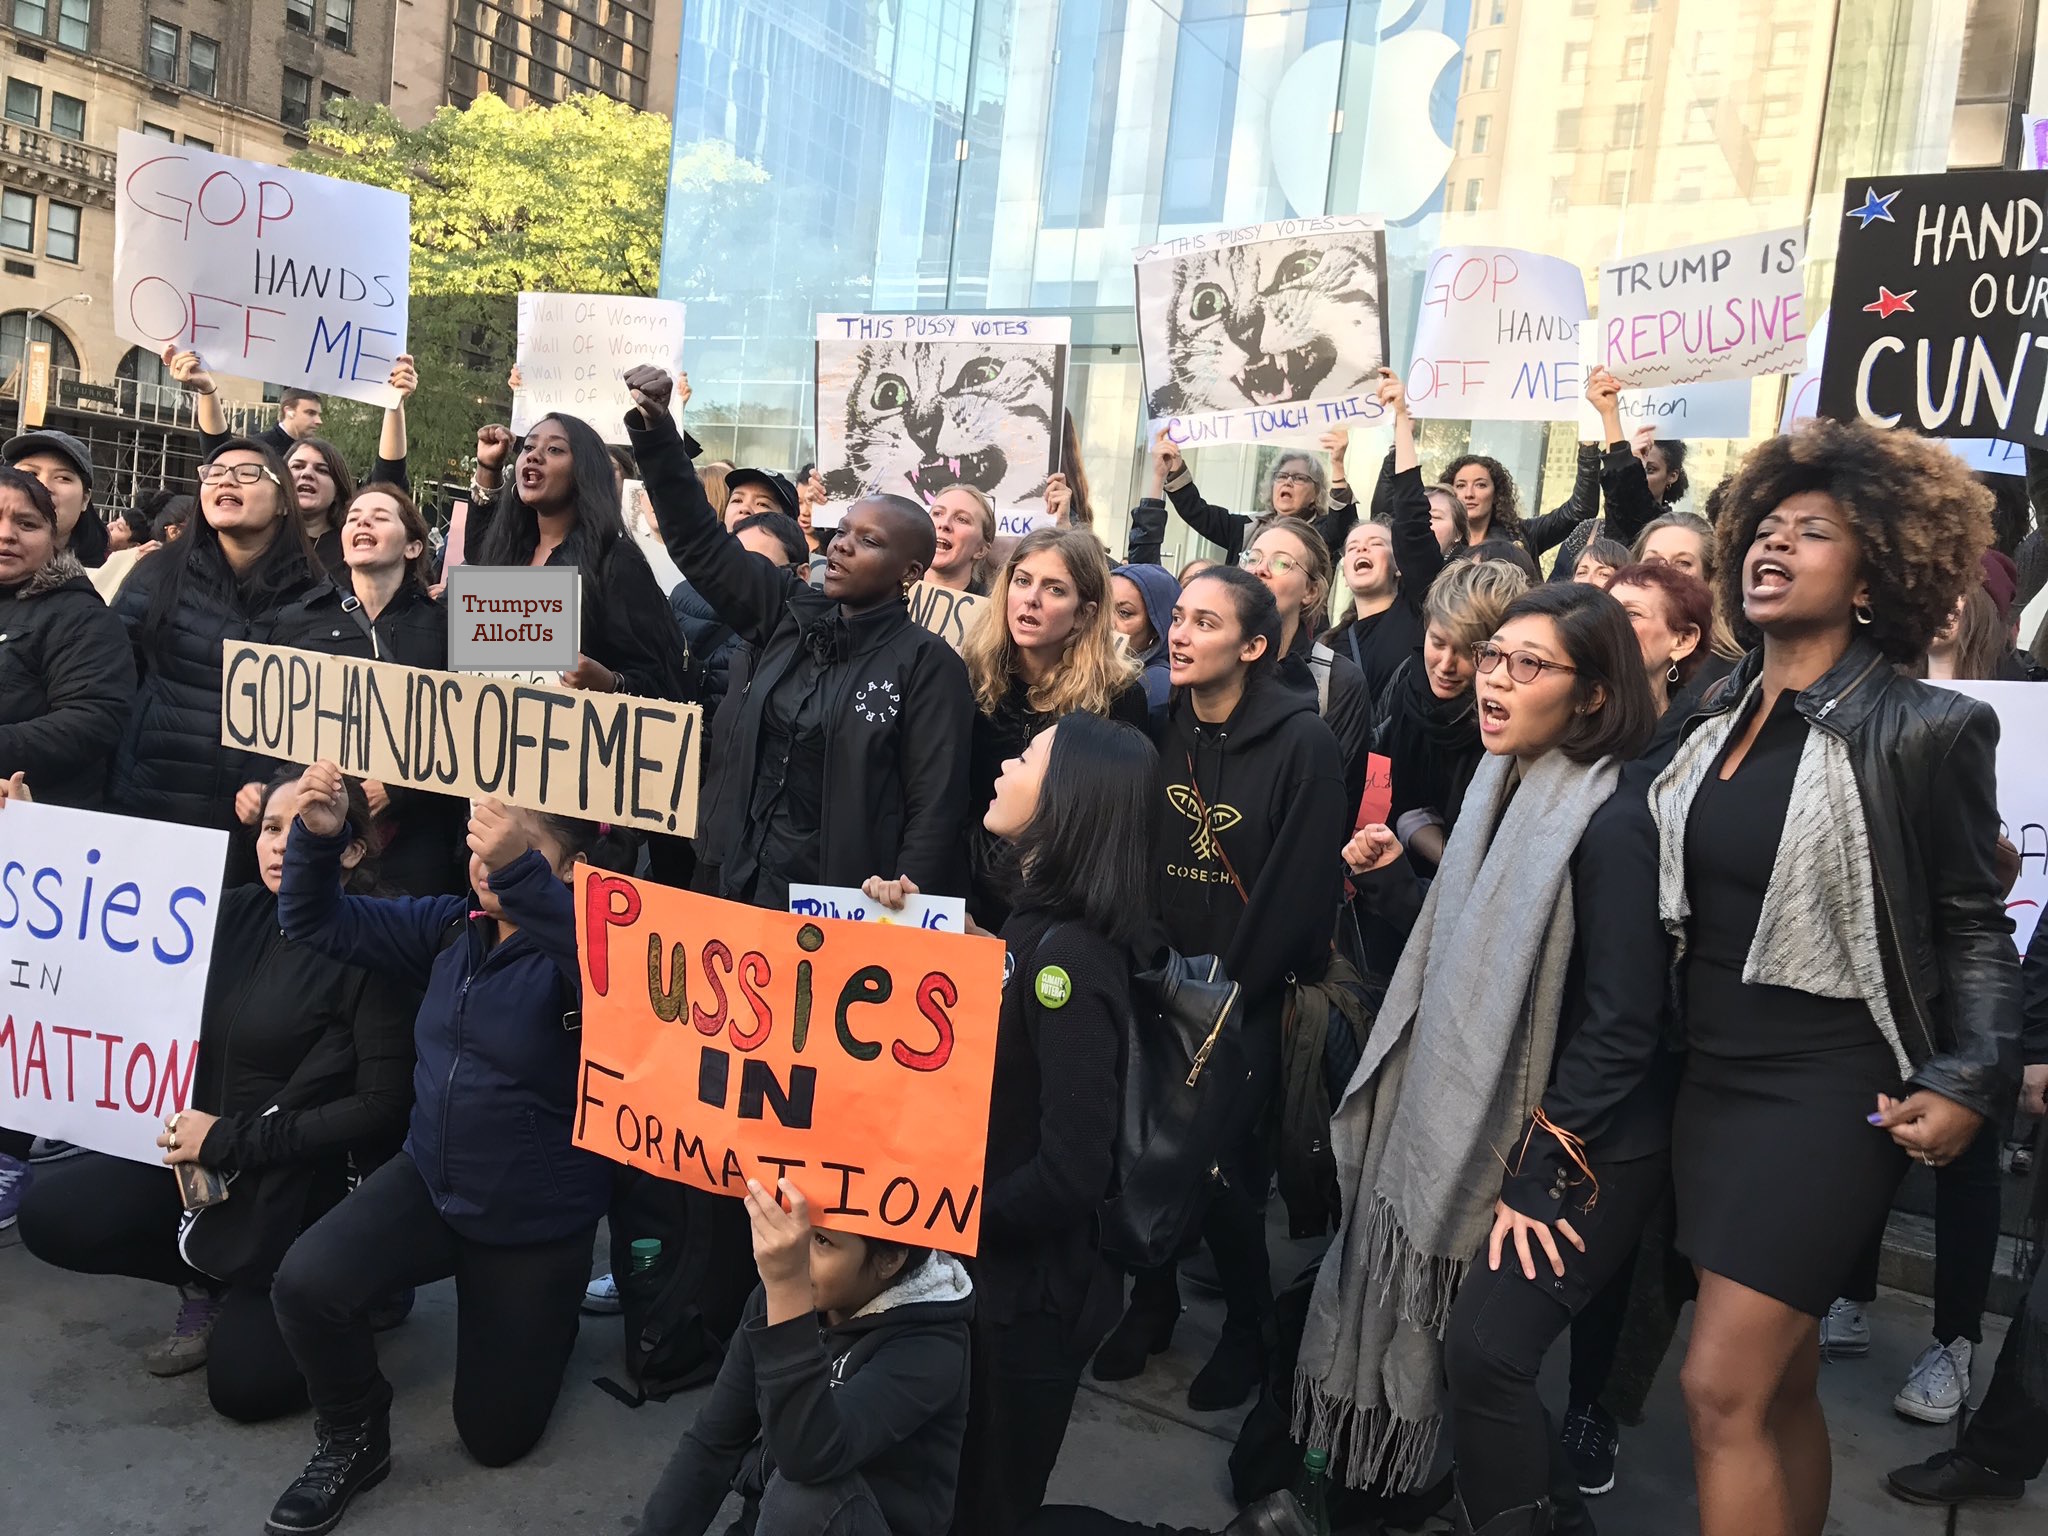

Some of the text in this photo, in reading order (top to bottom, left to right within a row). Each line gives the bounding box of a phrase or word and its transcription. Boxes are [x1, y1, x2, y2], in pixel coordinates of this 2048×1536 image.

[126, 155, 294, 241] GOP
[1164, 216, 1335, 257] THIS PUSSY VOTES
[1913, 198, 2048, 267] HAND
[254, 248, 395, 308] HANDS
[1424, 254, 1519, 318] GOP
[1606, 238, 1797, 297] TRUMP IS
[130, 276, 397, 385] OFF ME
[575, 302, 596, 323] Of
[606, 306, 668, 331] Womyn
[836, 316, 1029, 340] THIS PUSSY VOTES
[1607, 292, 1806, 368] REPULSIVE
[572, 334, 595, 354] Of
[608, 334, 670, 360] Womyn
[575, 364, 596, 381] Of
[1405, 357, 1491, 402] OFF
[1511, 360, 1580, 403] ME
[575, 388, 597, 403] Of
[1618, 394, 1688, 418] Action
[1167, 393, 1385, 444] CUNT TOUCH THIS
[998, 515, 1034, 534] ACK
[855, 680, 900, 723] CAMPFIRE
[1166, 864, 1235, 885] COSECH
[10, 959, 62, 996] IN
[586, 871, 959, 1072] Pussies
[1041, 972, 1065, 988] CLIMATE
[697, 1045, 818, 1130] IN
[576, 1059, 980, 1235] FORMATION
